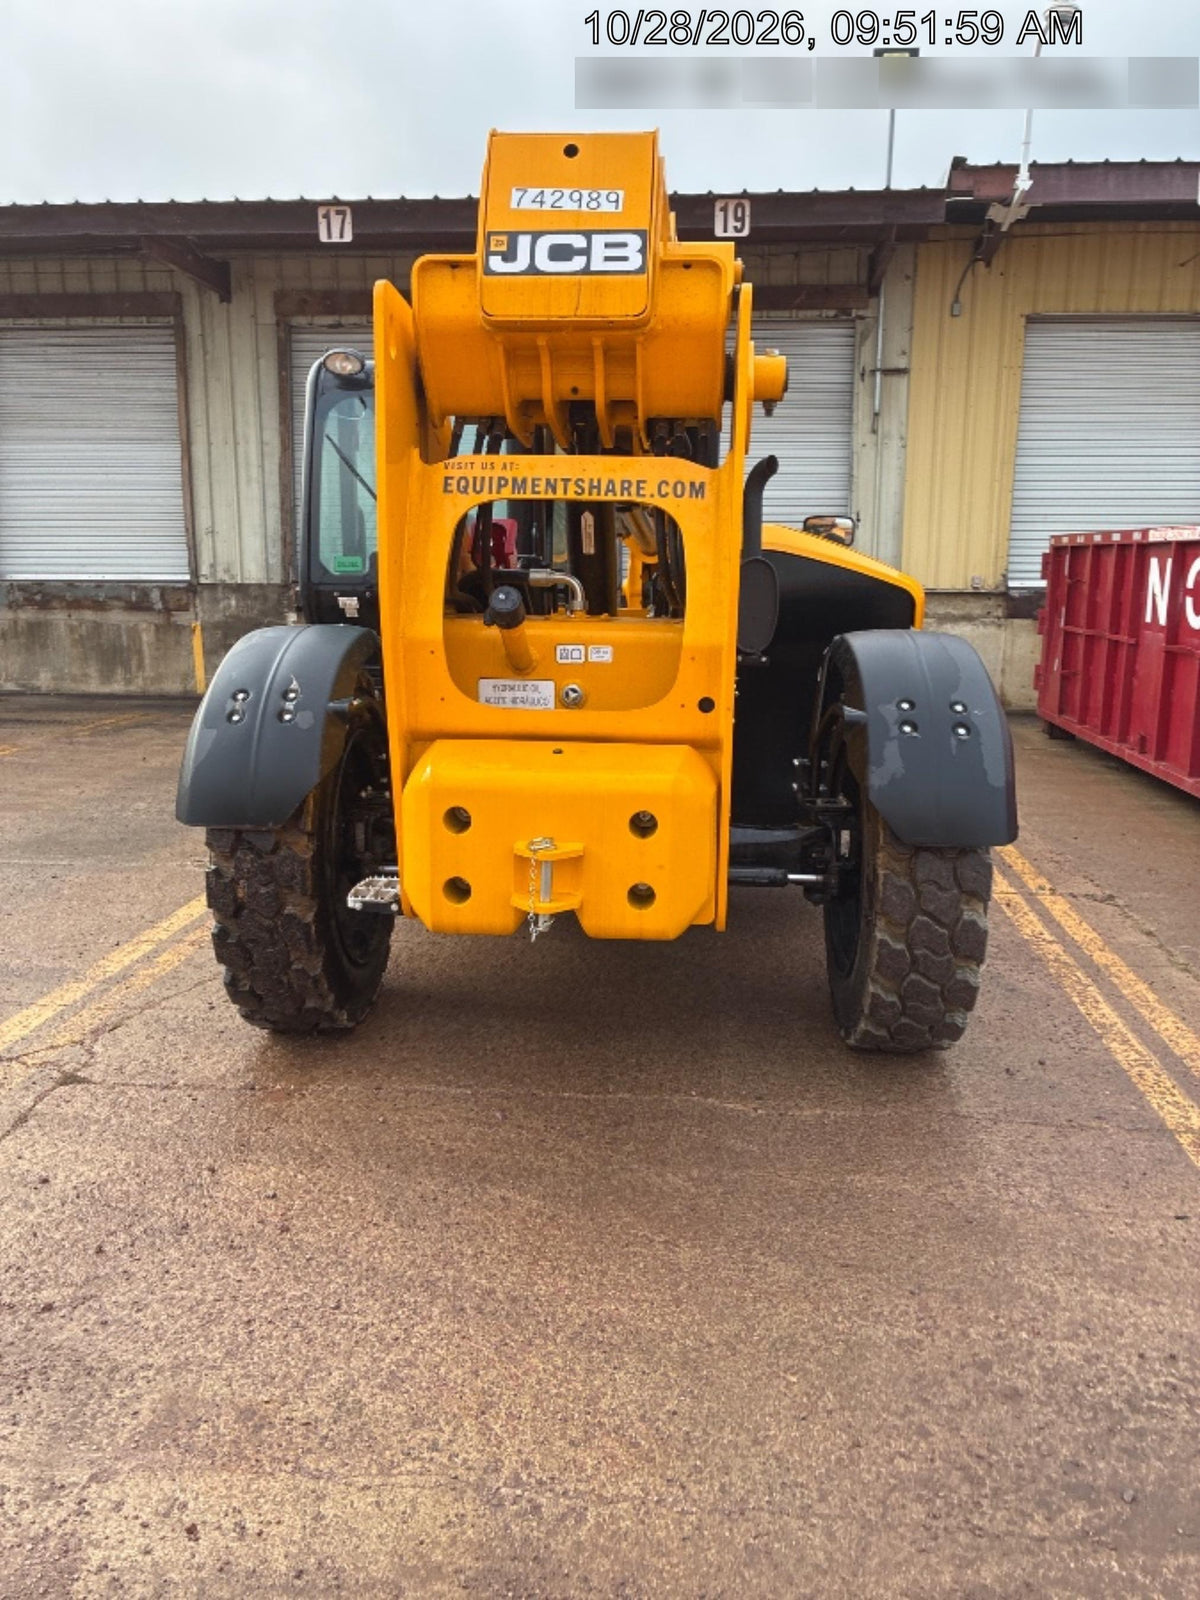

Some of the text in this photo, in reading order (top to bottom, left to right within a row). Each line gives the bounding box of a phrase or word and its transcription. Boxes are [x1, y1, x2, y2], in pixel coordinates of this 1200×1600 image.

[515, 188, 620, 210] 742989
[321, 208, 347, 240] 17
[720, 201, 746, 234] 19
[488, 233, 643, 273] JCB
[443, 461, 520, 472] VISIT US AT:
[442, 475, 707, 499] EQUIPMENTSHARE.COM
